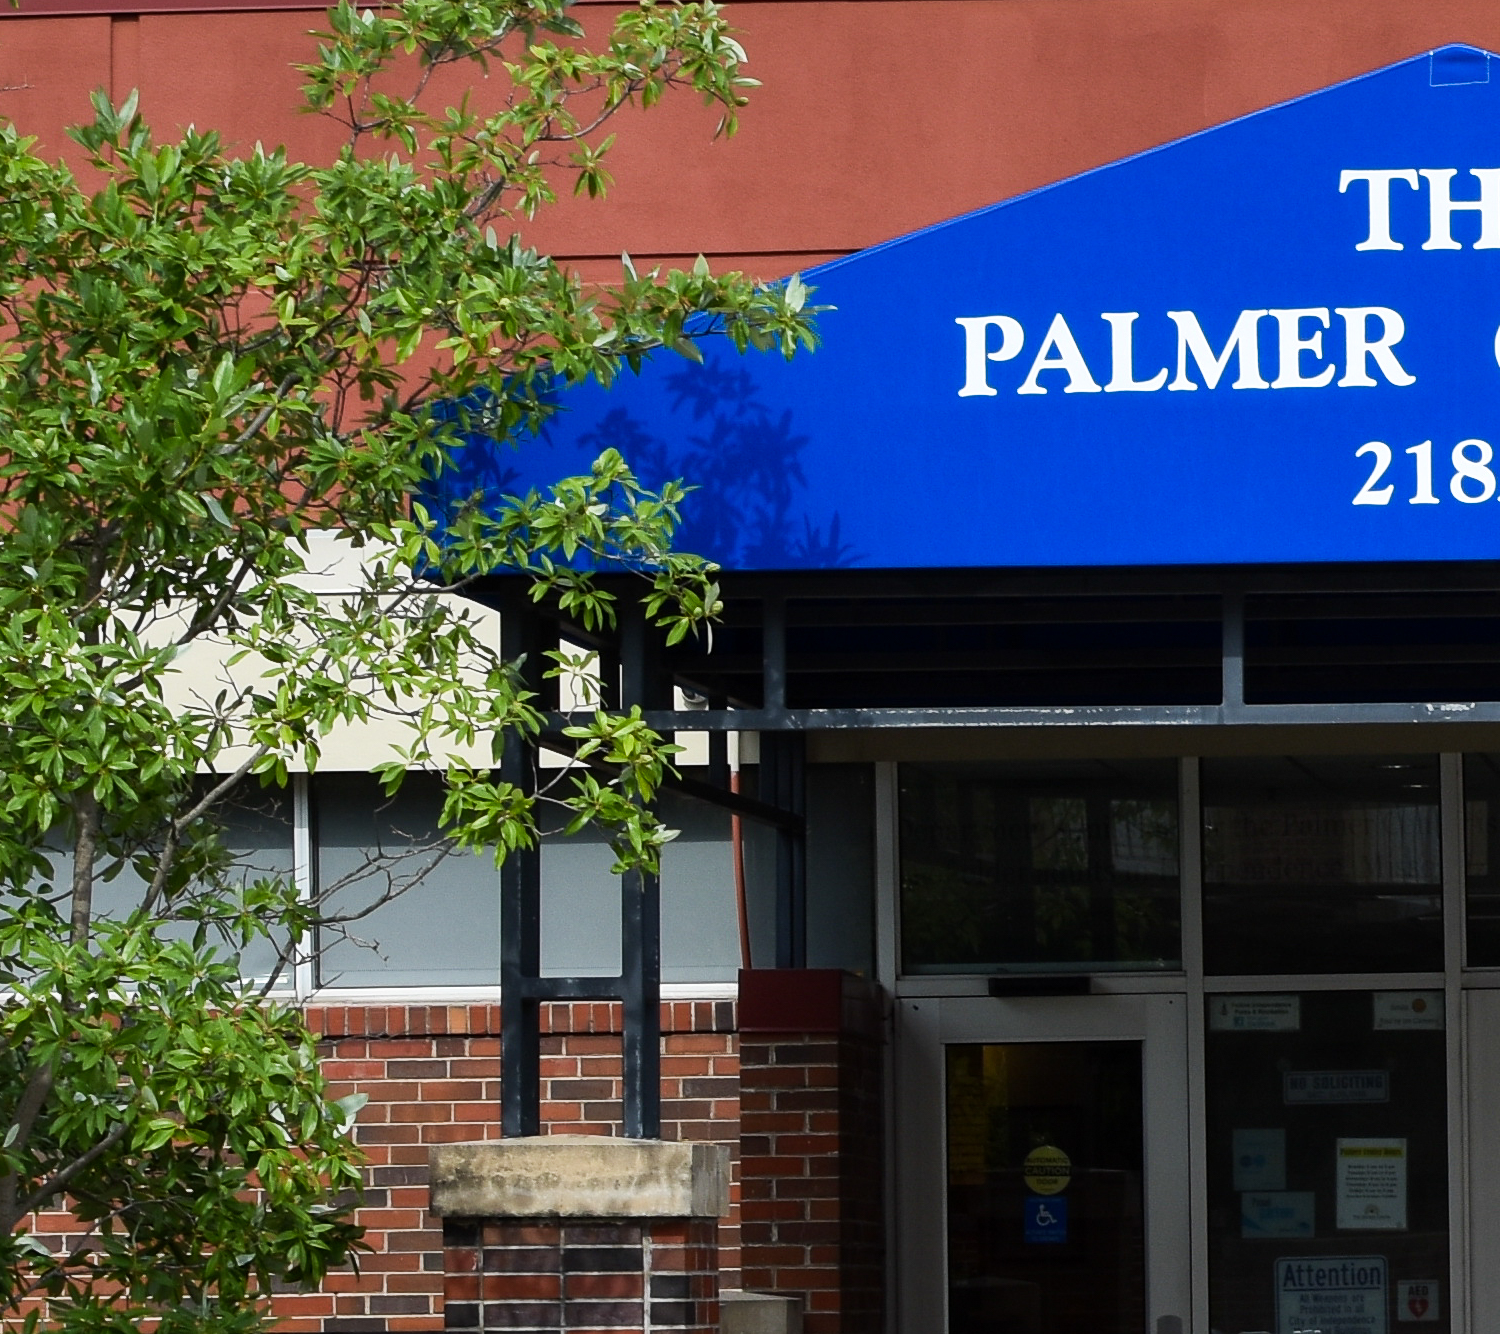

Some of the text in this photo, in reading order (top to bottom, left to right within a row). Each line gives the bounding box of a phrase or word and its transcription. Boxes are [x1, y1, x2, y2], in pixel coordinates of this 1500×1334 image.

[955, 307, 1417, 397] PALMER
[1290, 1075, 1383, 1090] NO SOLICITING
[1024, 1166, 1070, 1176] CAUTION
[1283, 1262, 1381, 1287] Attention
[1408, 1285, 1429, 1296] AED
[1312, 1293, 1348, 1305] Weapons
[1300, 1304, 1341, 1314] Prohibited
[1289, 1315, 1306, 1327] City
[1320, 1315, 1376, 1327] Independence
